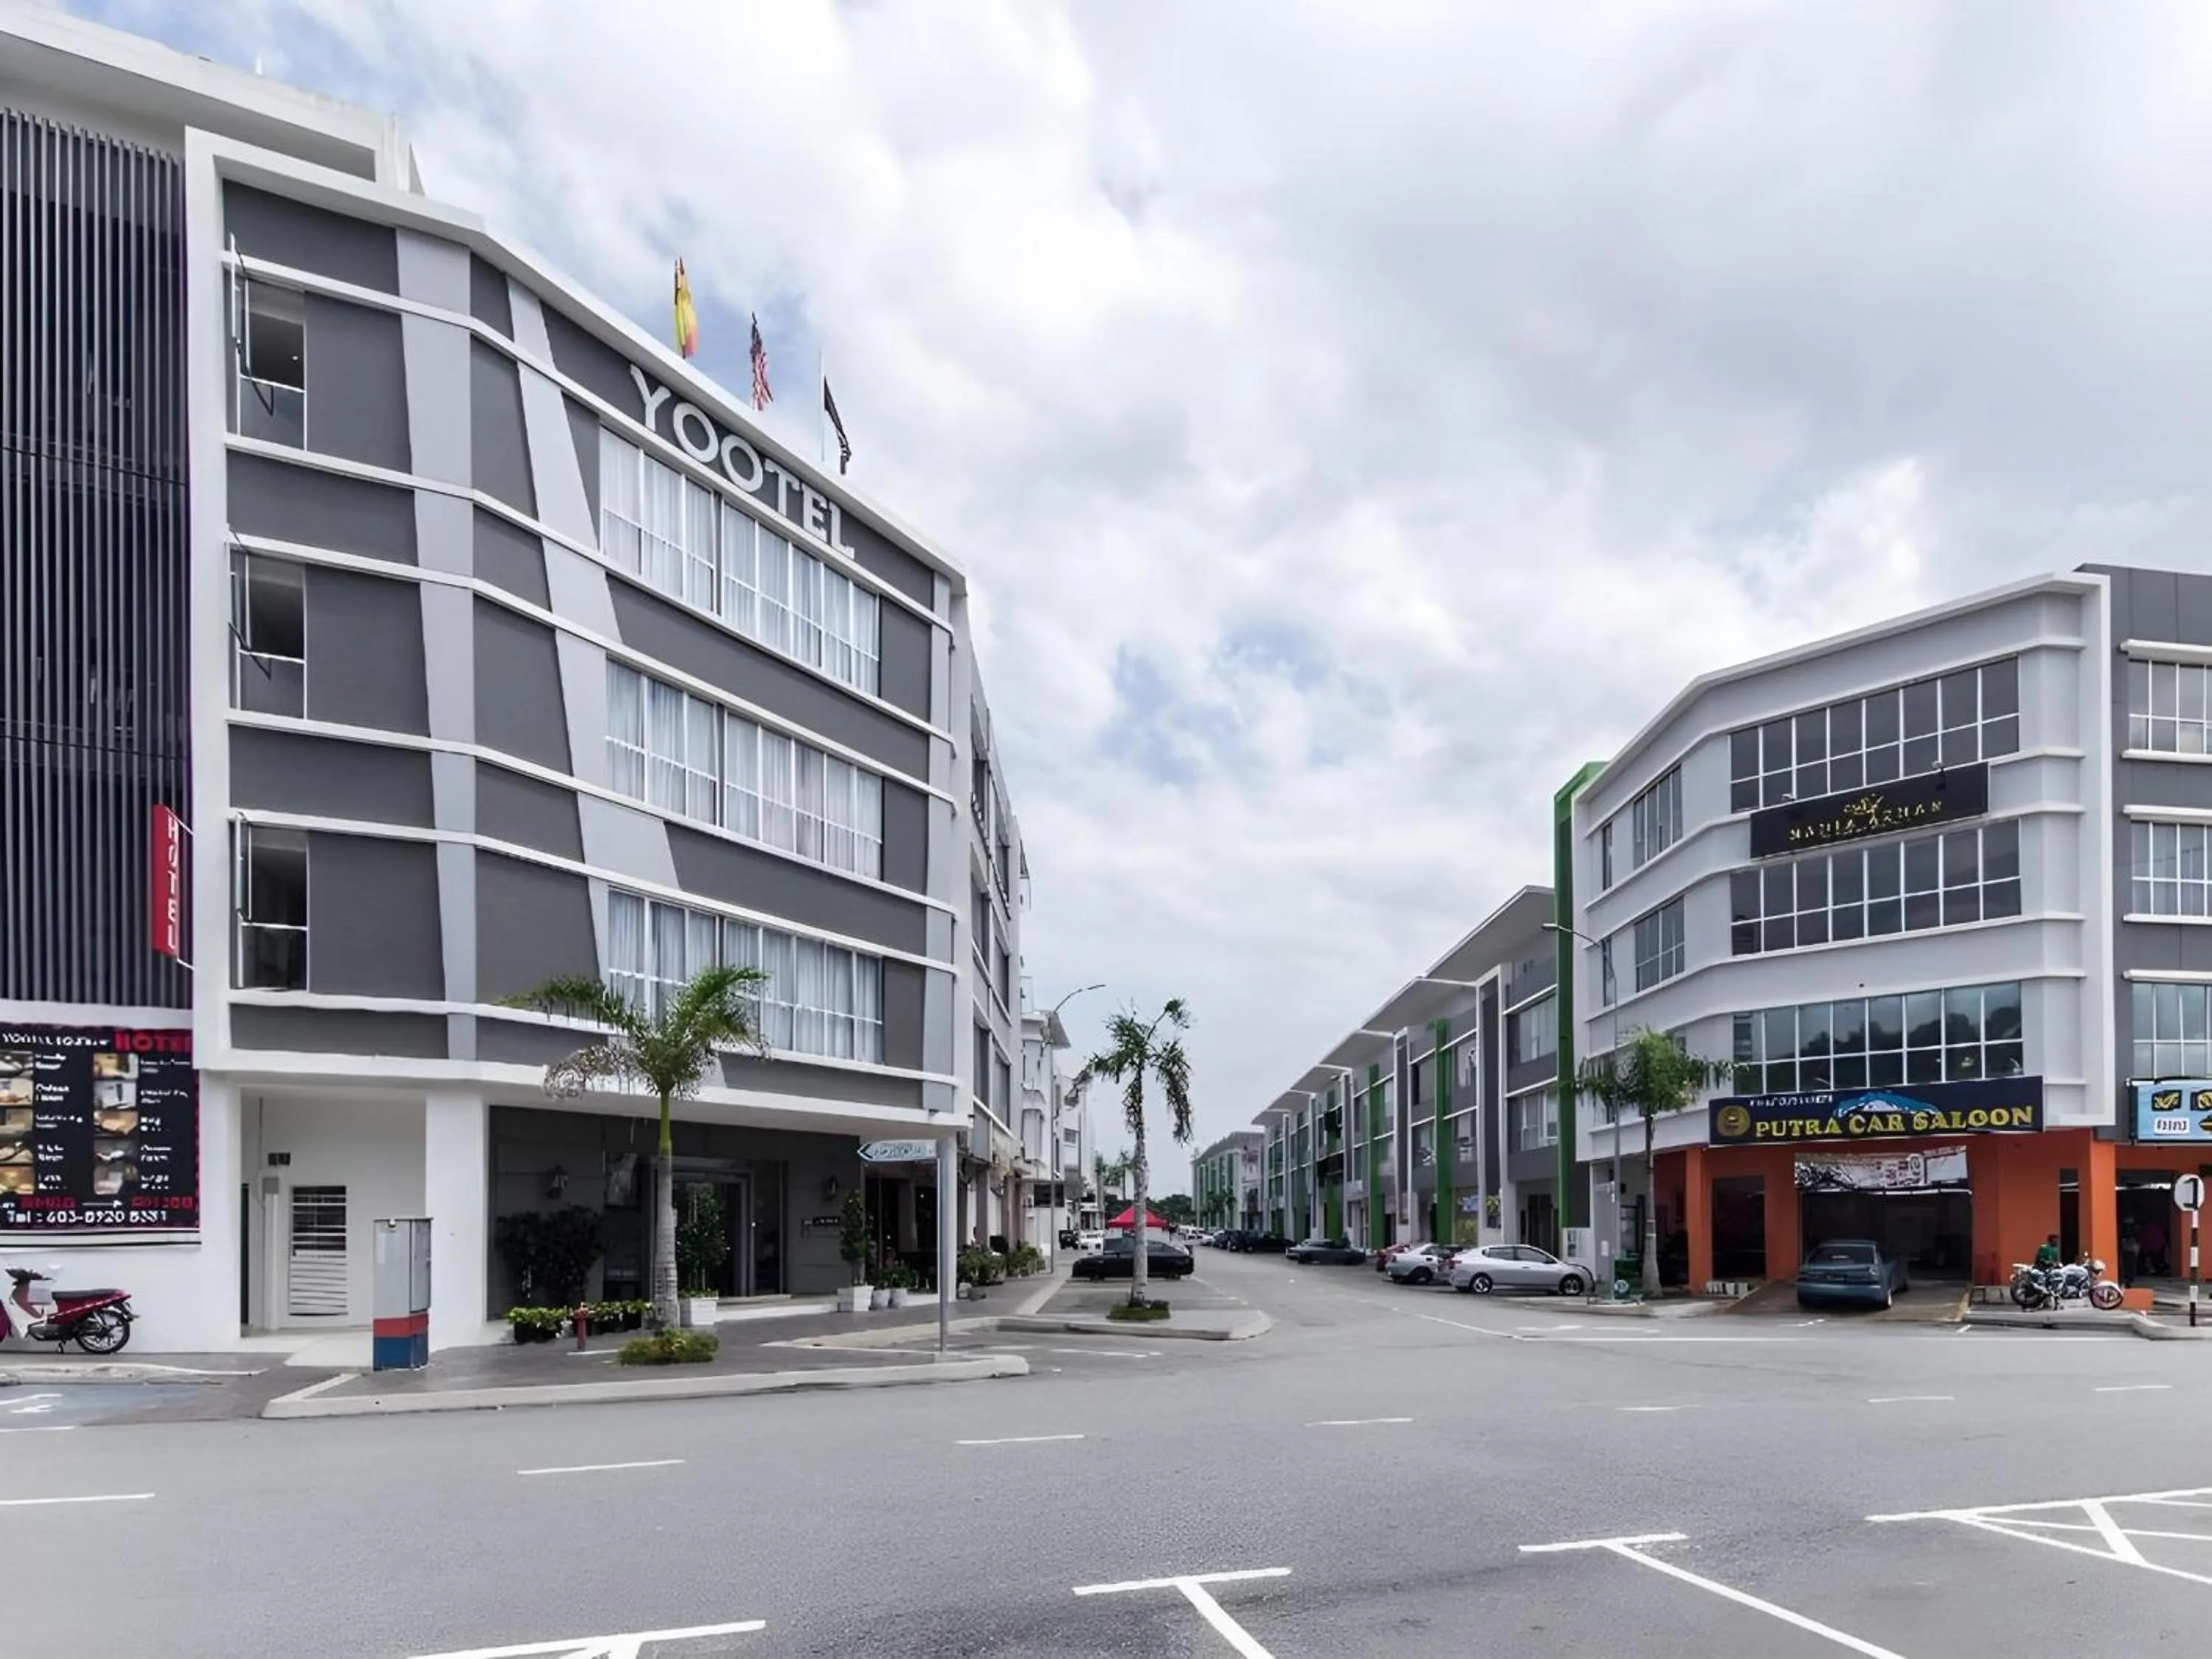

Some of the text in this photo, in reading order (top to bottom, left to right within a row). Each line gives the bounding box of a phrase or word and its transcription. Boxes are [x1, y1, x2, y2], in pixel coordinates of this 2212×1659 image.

[630, 364, 855, 560] YOOTEL
[167, 815, 179, 950] HOTEL
[1756, 1106, 2033, 1137] PUTRA CAR SALOON
